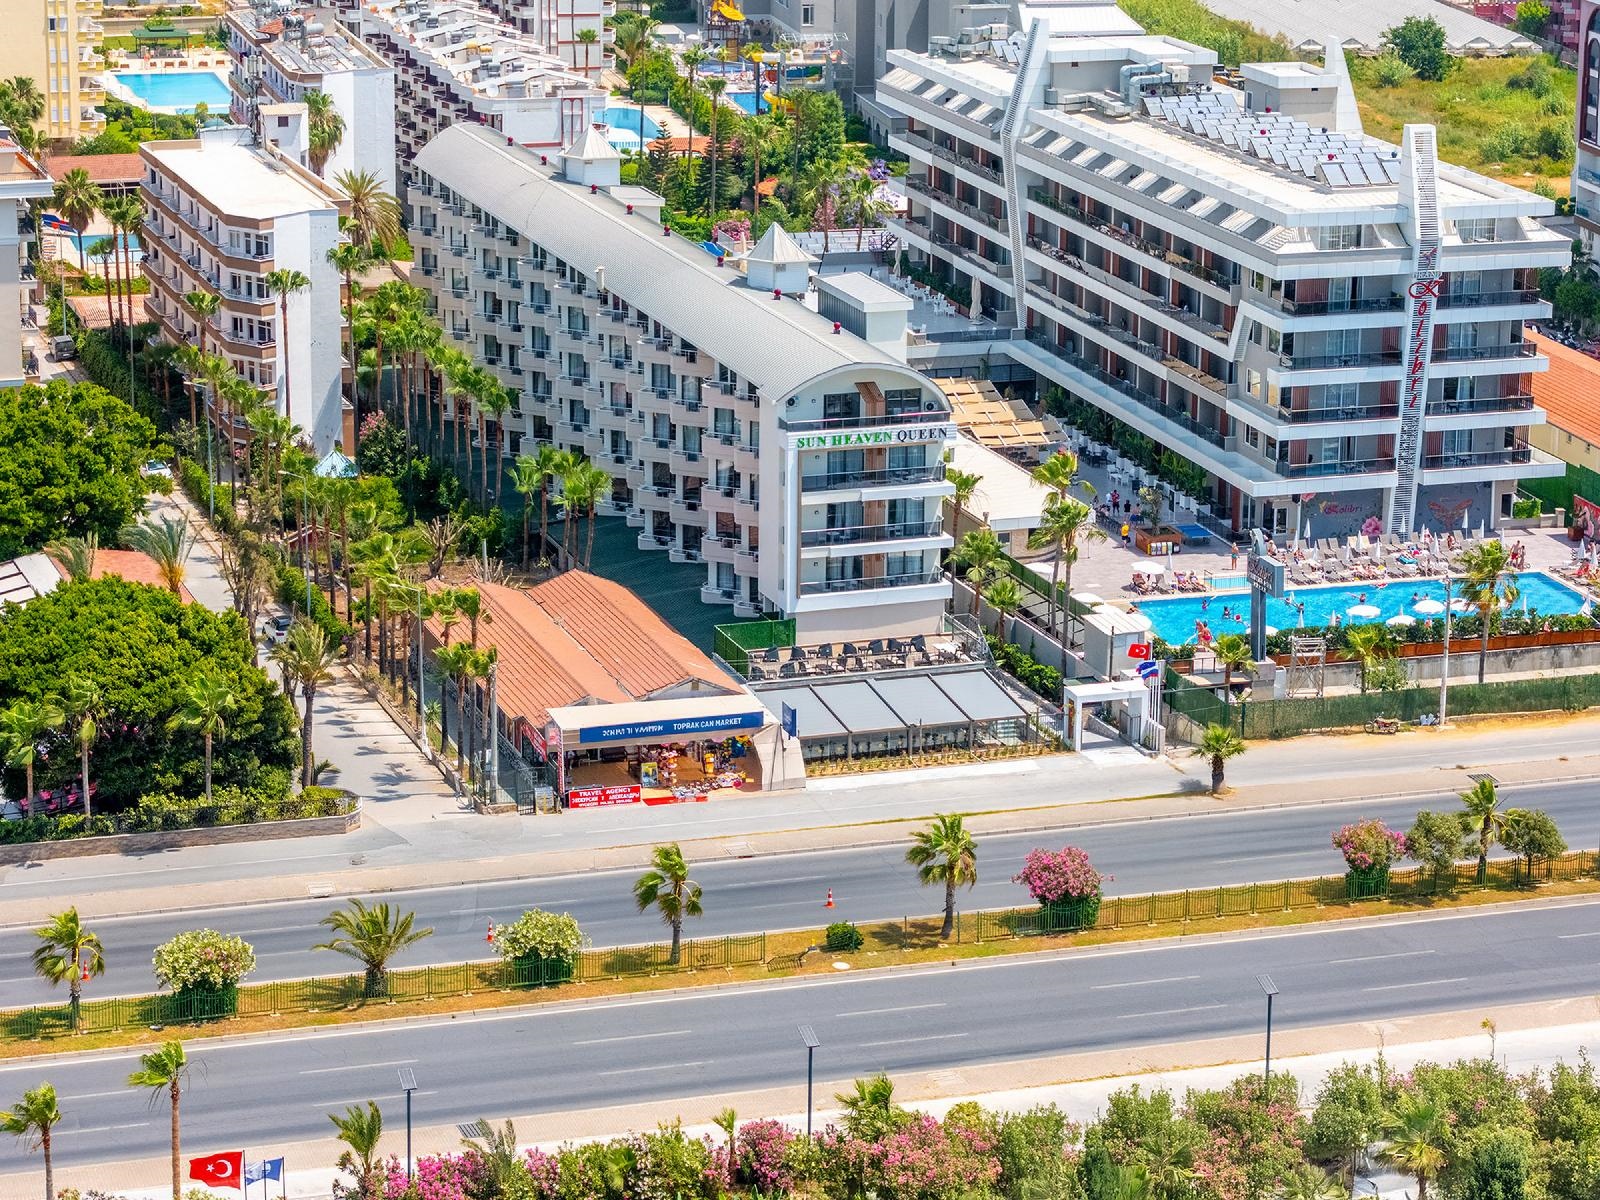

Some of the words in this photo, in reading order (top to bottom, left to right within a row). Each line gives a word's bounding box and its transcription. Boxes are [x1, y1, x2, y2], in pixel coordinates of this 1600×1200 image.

[1408, 279, 1443, 408] Kolibri
[797, 436, 826, 449] SUN
[831, 431, 892, 447] HEAVEN
[897, 427, 948, 442] QUEEN
[673, 719, 700, 730] TOPRAK
[700, 719, 714, 728] CAN
[715, 717, 743, 727] MARKET
[606, 787, 631, 795] AGENCY
